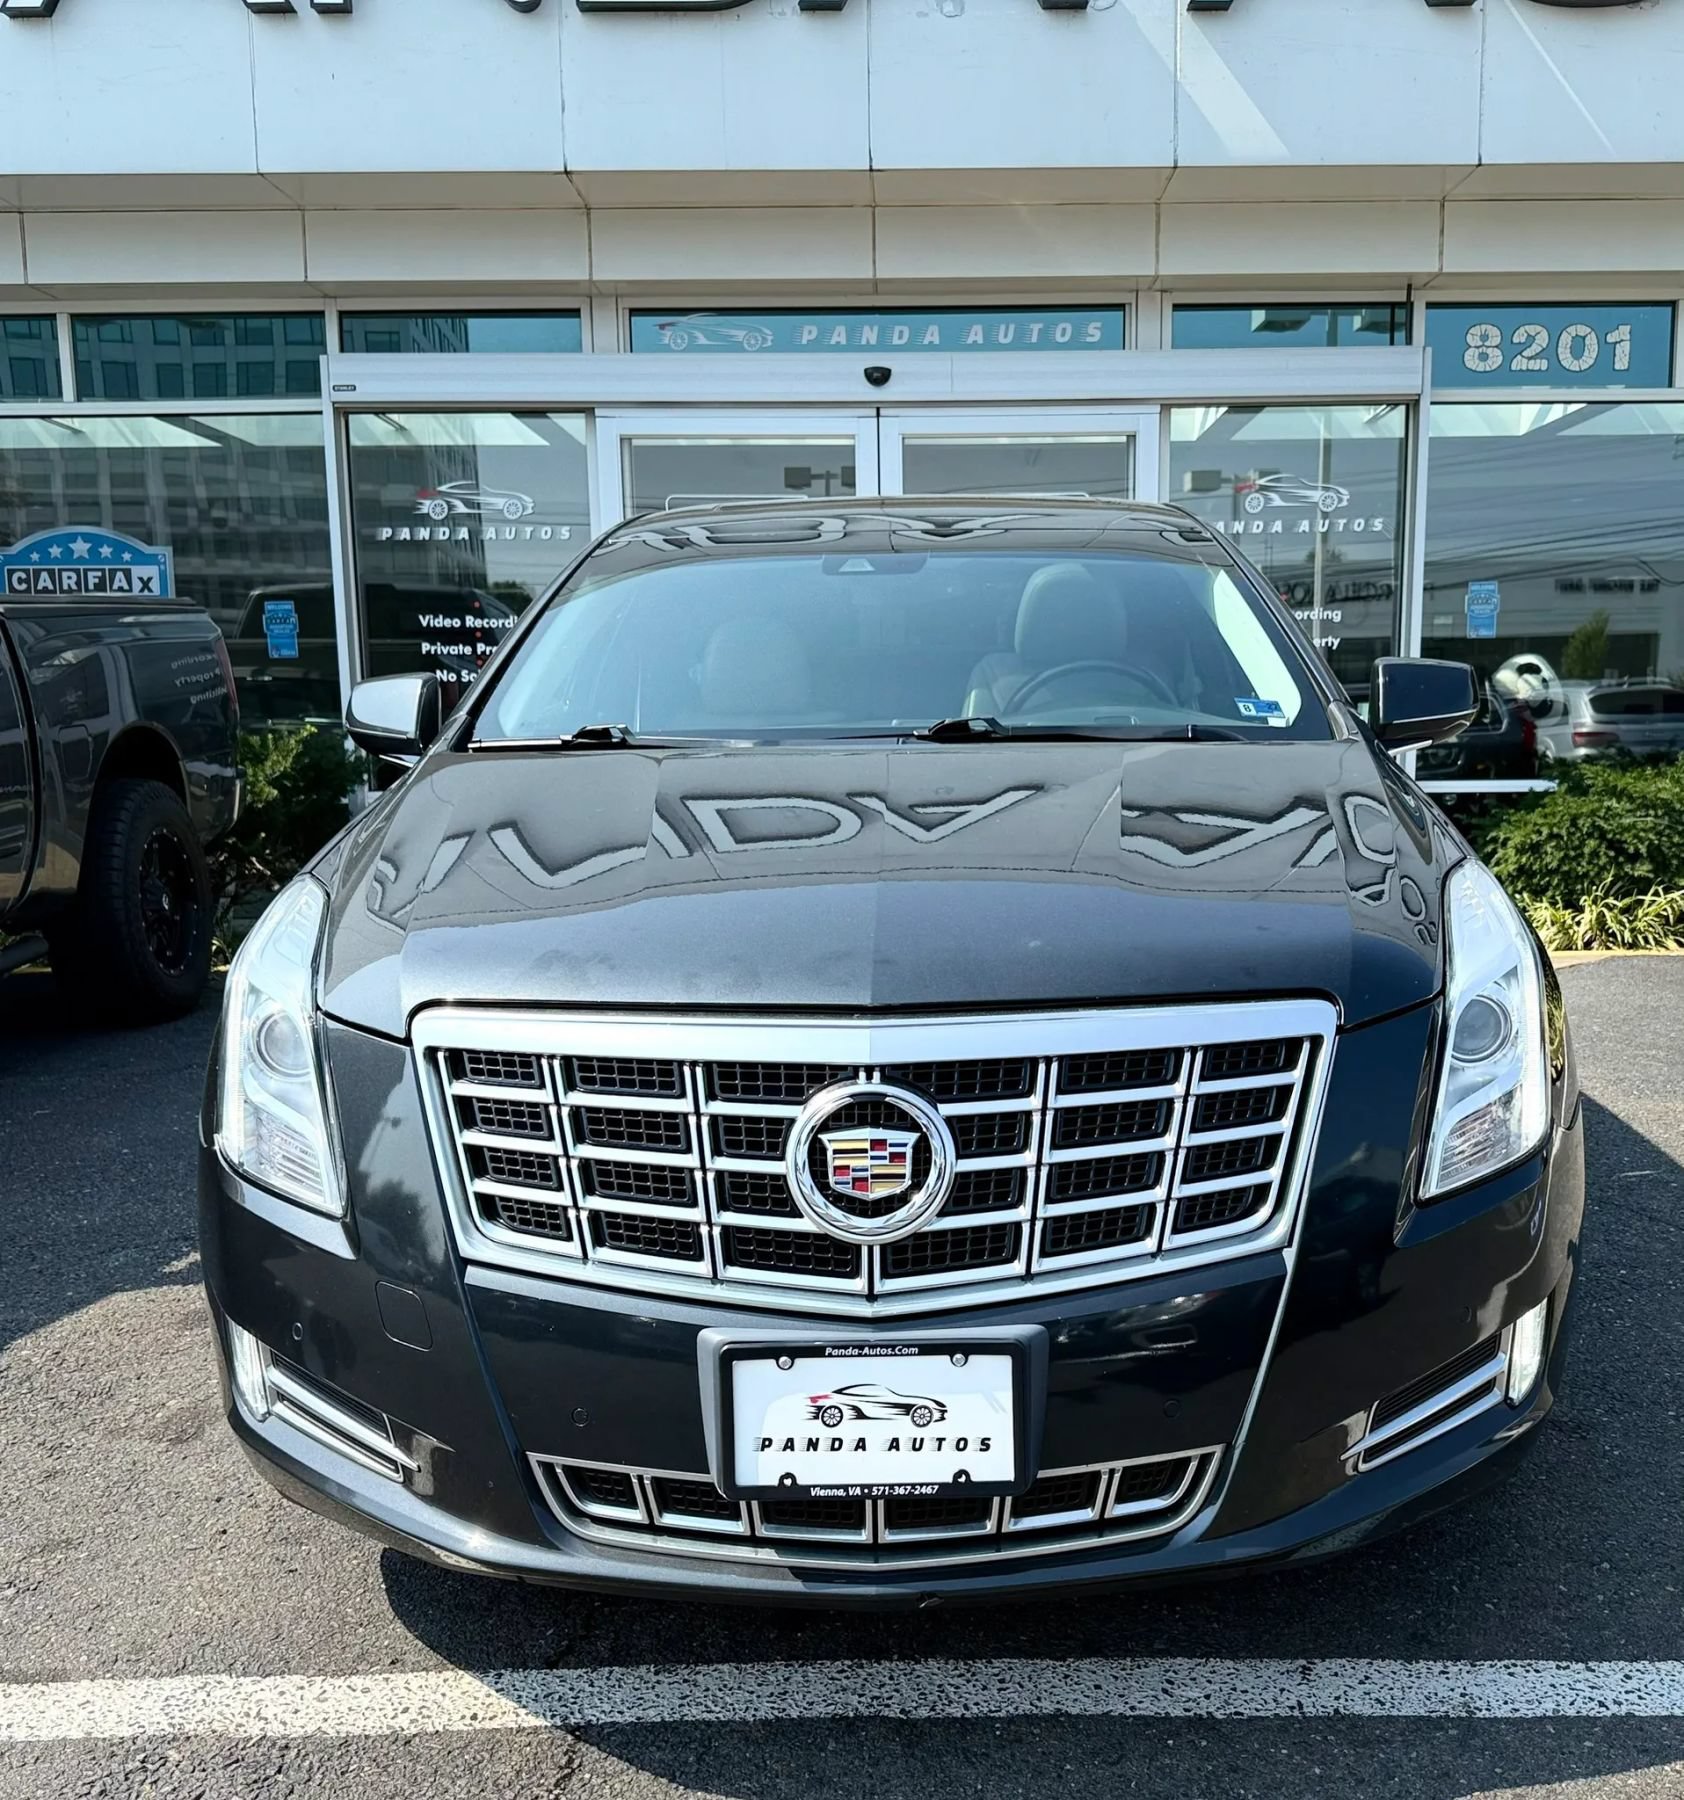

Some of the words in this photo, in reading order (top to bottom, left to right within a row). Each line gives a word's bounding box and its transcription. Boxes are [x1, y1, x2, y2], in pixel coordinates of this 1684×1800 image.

[798, 324, 941, 346] PANDA
[965, 321, 1103, 345] AUTOS
[1462, 322, 1632, 374] 8201
[380, 526, 470, 541] PANDA
[485, 525, 572, 541] AUTOS
[1213, 520, 1283, 534] ANDA
[1298, 518, 1384, 533] AUTOS
[10, 570, 154, 594] CARFAX
[418, 614, 461, 628] Video
[1294, 609, 1342, 622] ording
[421, 642, 472, 655] Private
[435, 670, 458, 682] No
[824, 1345, 919, 1357] Panda-Autos.Com
[758, 1436, 867, 1452] PANDA
[886, 1436, 992, 1452] AUTOS
[809, 1486, 847, 1498] Vienna,
[847, 1486, 861, 1496] VA
[871, 1484, 939, 1496] 571-367-2467
